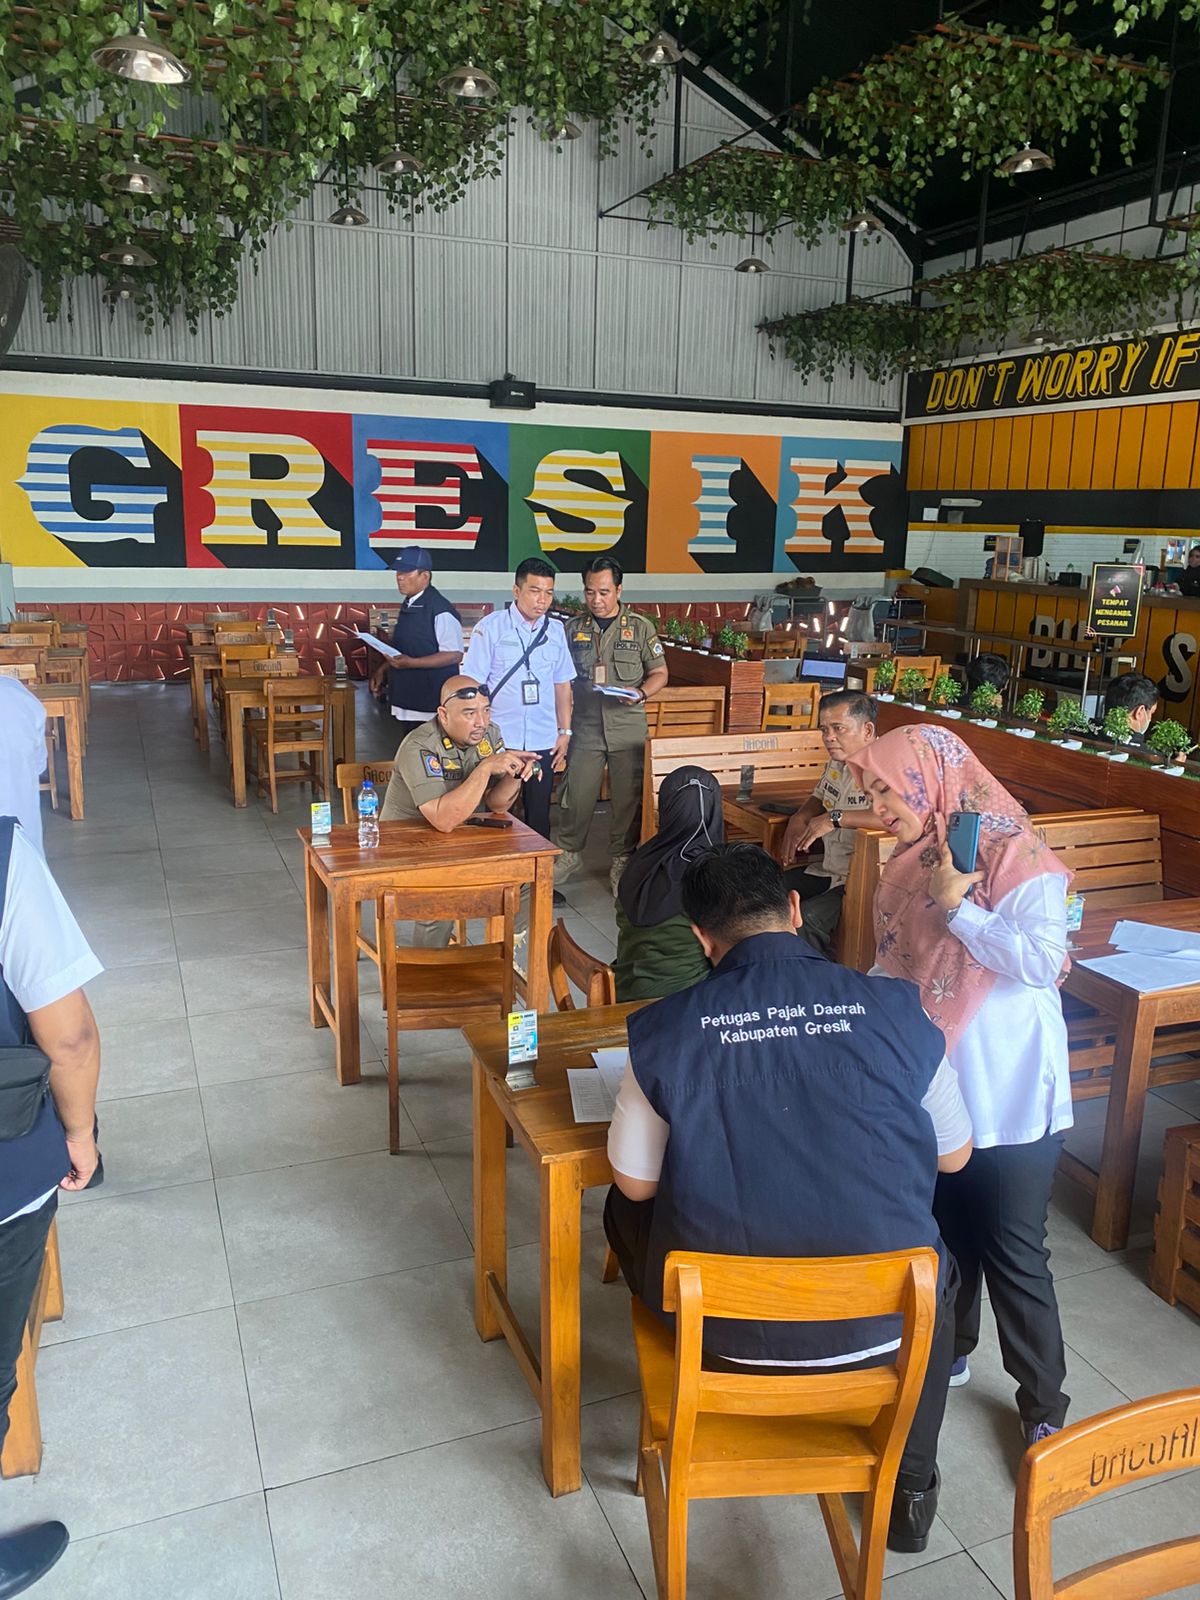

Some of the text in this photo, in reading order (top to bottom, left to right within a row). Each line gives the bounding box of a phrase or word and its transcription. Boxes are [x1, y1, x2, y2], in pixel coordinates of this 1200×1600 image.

[926, 332, 1200, 412] DON'T WORRY IF
[16, 424, 891, 553] GRESIK
[701, 1002, 866, 1028] Petugas Pajak Daerah
[720, 1019, 852, 1044] Kabupaten Gresik
